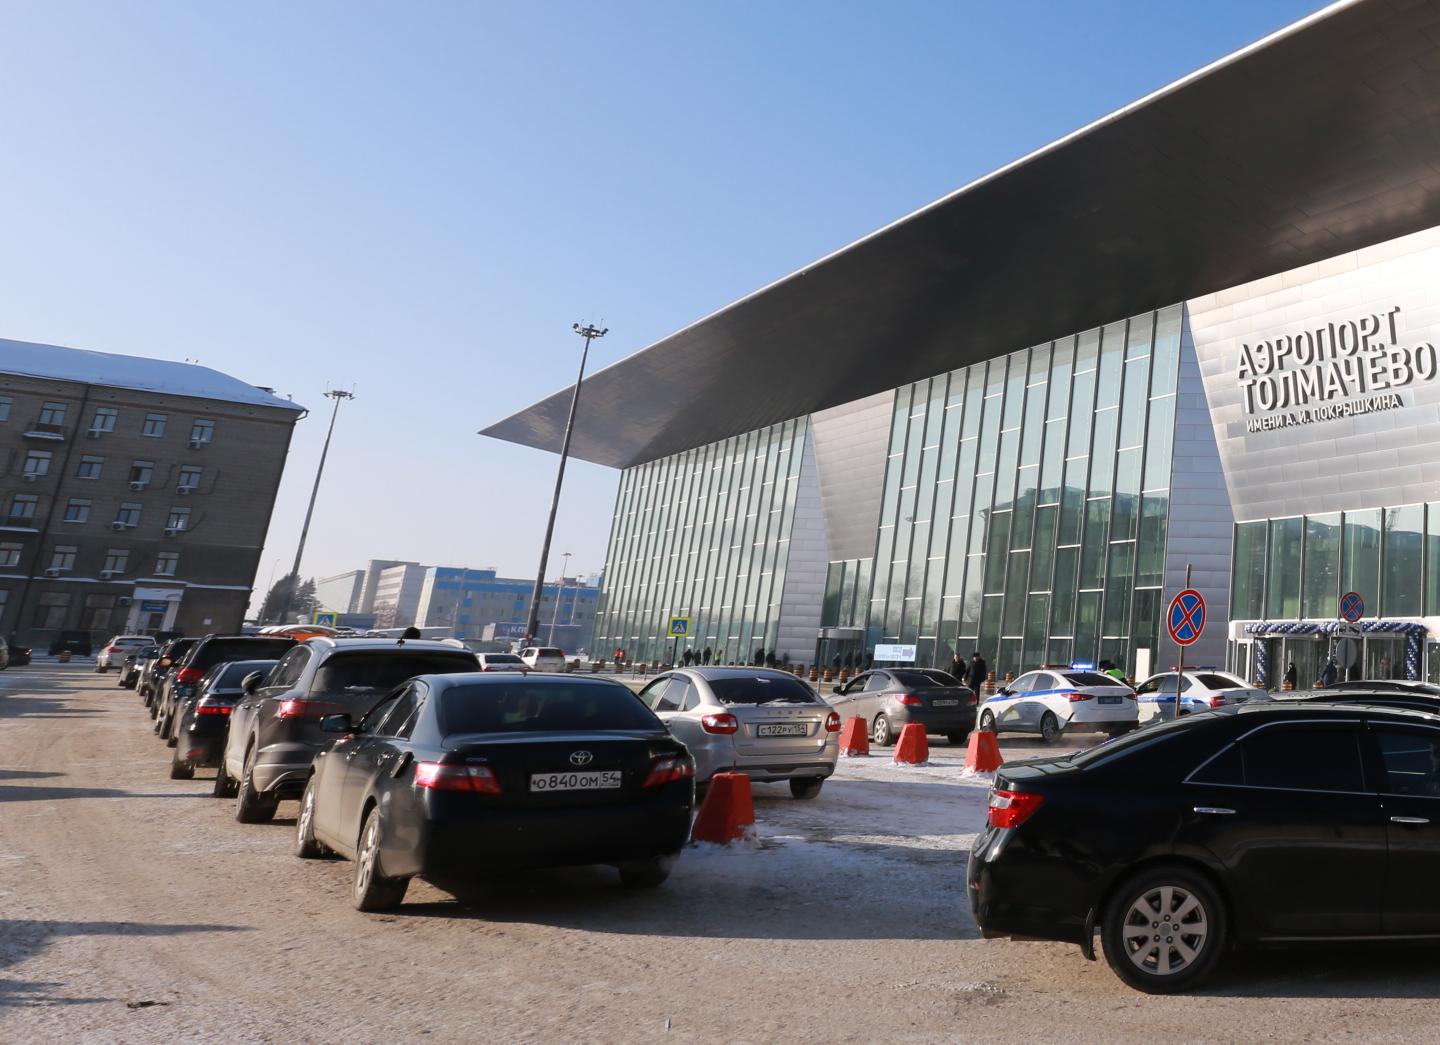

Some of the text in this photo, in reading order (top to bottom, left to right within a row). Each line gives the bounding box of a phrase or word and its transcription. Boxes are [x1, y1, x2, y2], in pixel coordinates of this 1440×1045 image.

[1238, 342, 1437, 414] ТОЛМАЧЁВО
[1239, 305, 1401, 379] АЭРОПОРТ
[1246, 413, 1285, 432] ИМЕНИ
[1313, 394, 1404, 421] ПОКРЫШКИНА
